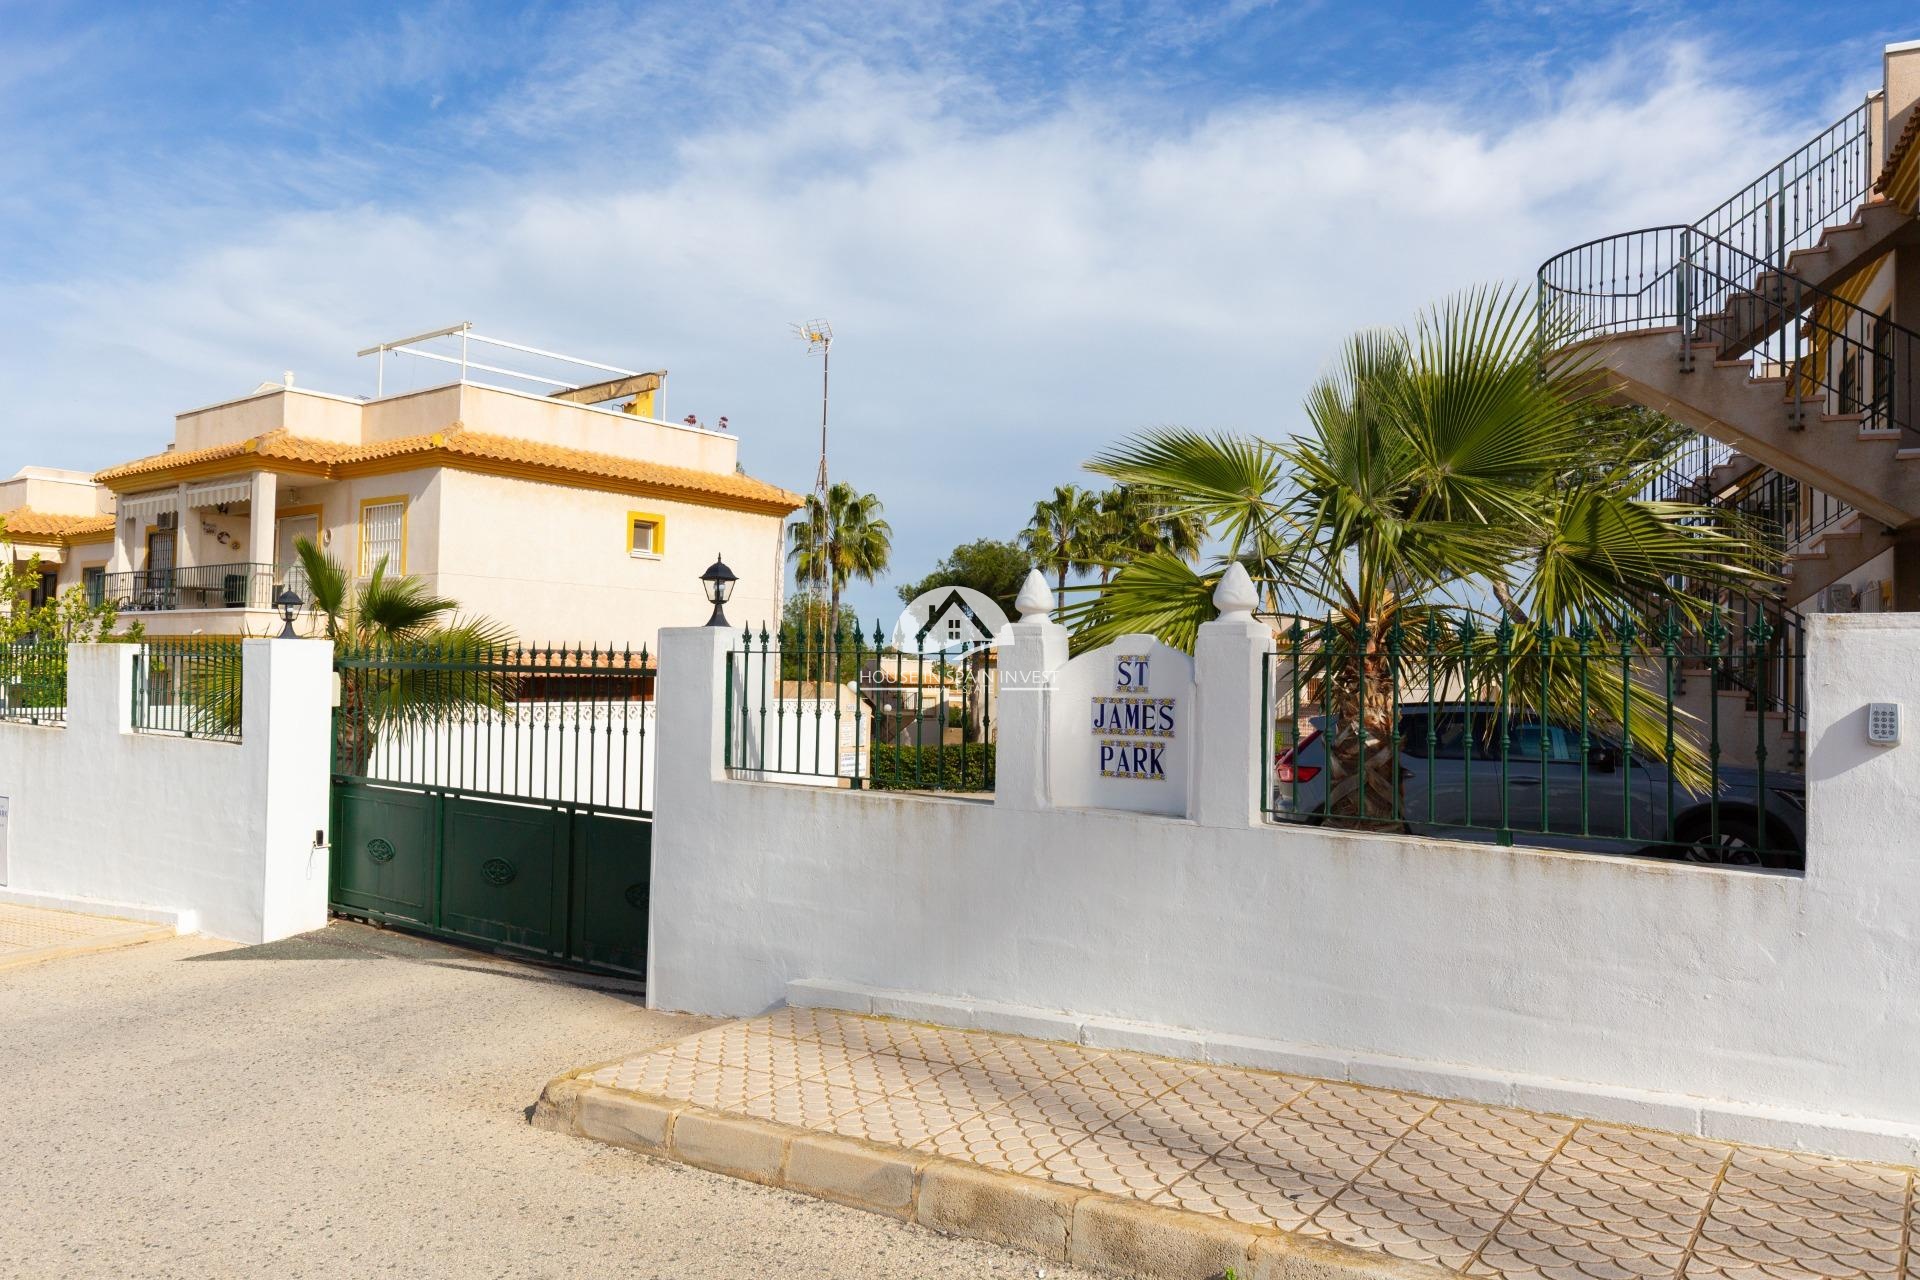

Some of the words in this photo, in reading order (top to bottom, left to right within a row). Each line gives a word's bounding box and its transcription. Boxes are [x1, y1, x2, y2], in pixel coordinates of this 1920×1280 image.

[1117, 661, 1149, 686] ST
[1093, 703, 1175, 731] JAMES
[1100, 745, 1165, 774] PARK
